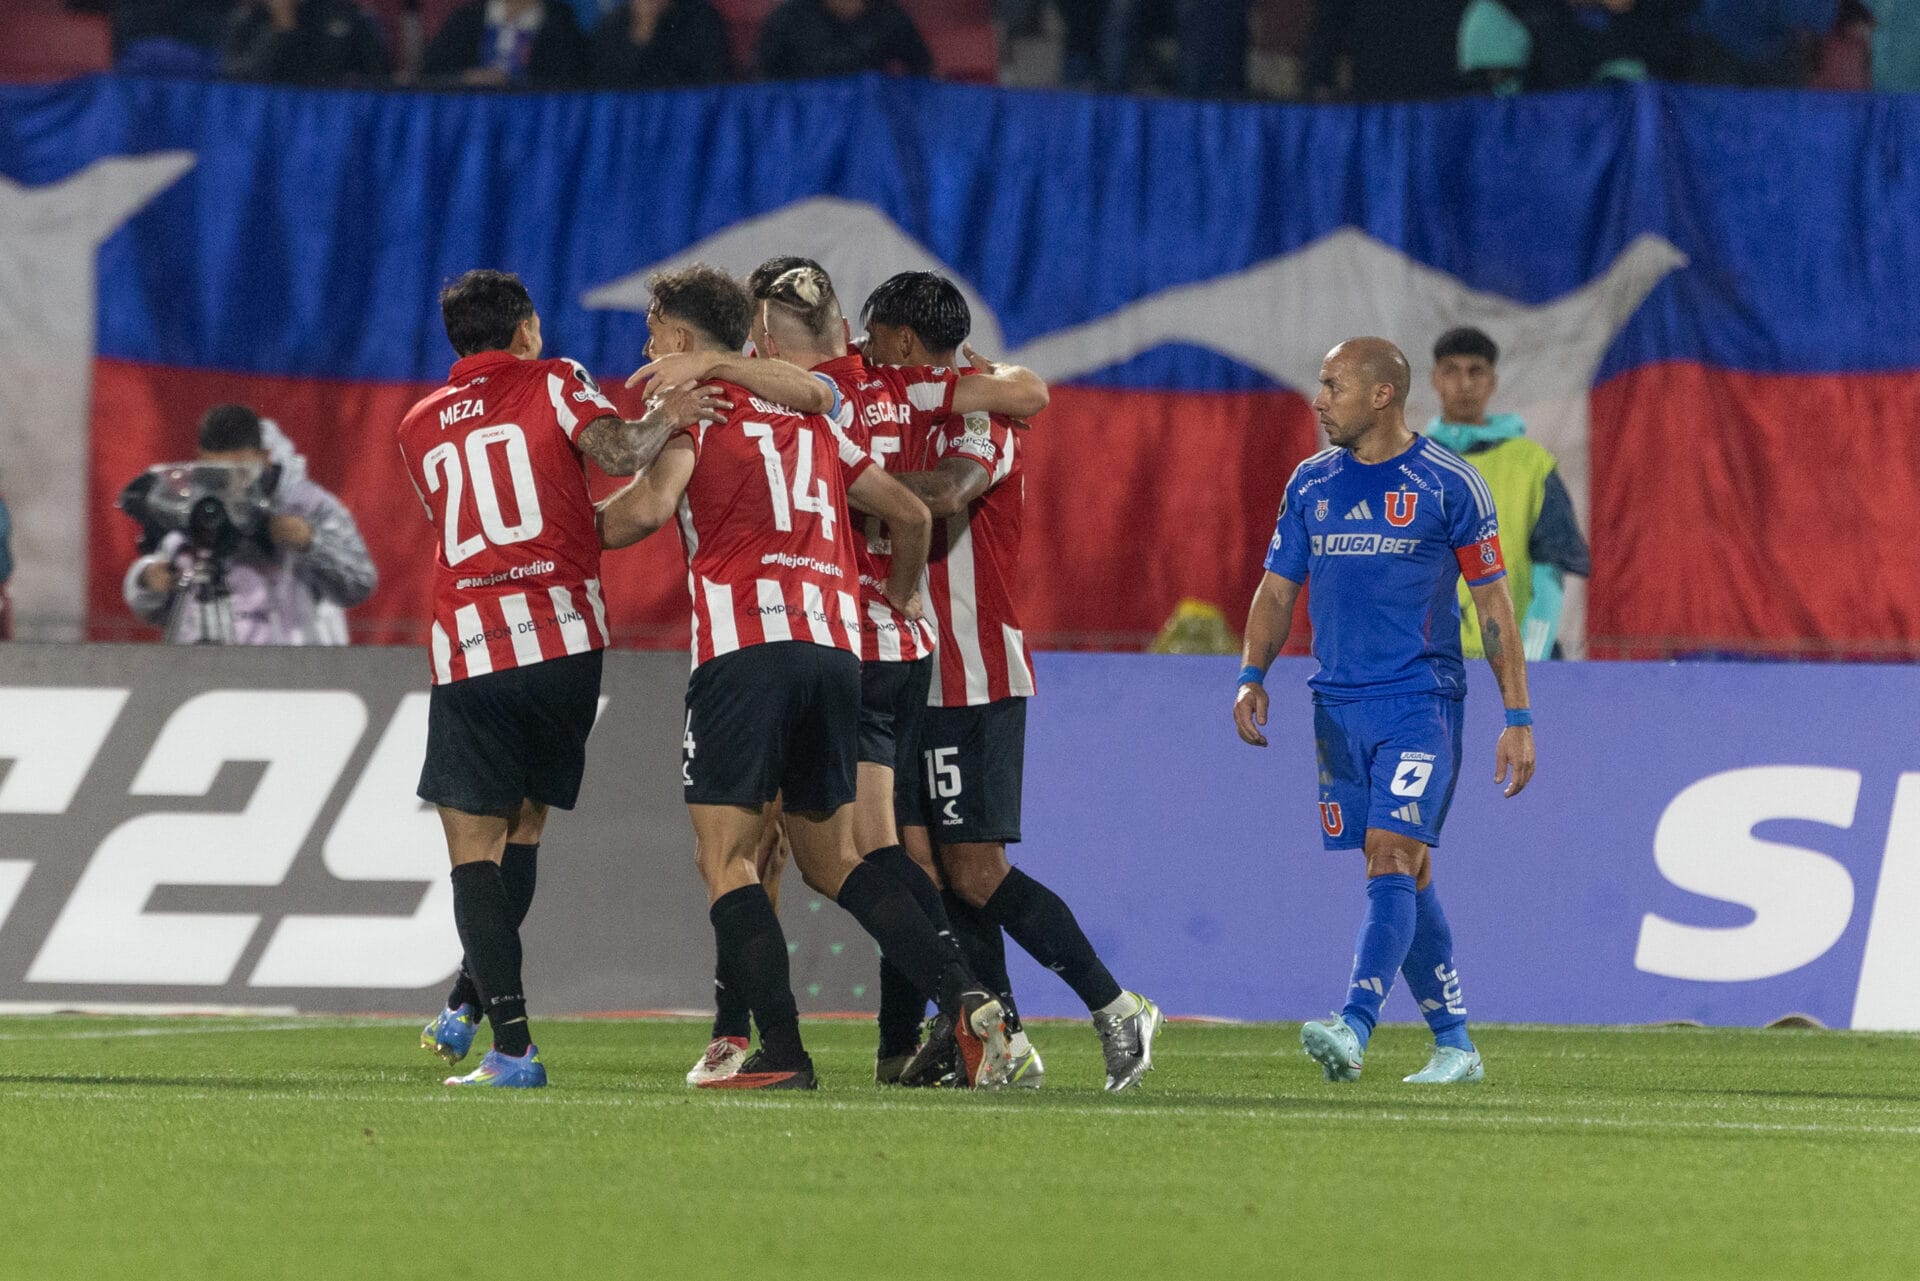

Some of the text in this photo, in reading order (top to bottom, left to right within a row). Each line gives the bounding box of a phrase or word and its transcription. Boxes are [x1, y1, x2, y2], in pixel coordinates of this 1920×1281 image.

[439, 400, 484, 430] MEZA
[422, 423, 544, 568] 20
[742, 421, 837, 542] 14
[1384, 491, 1419, 527] U
[517, 620, 544, 634] DEL
[548, 611, 585, 626] MUND
[924, 746, 963, 800] 15
[1318, 802, 1344, 837] U
